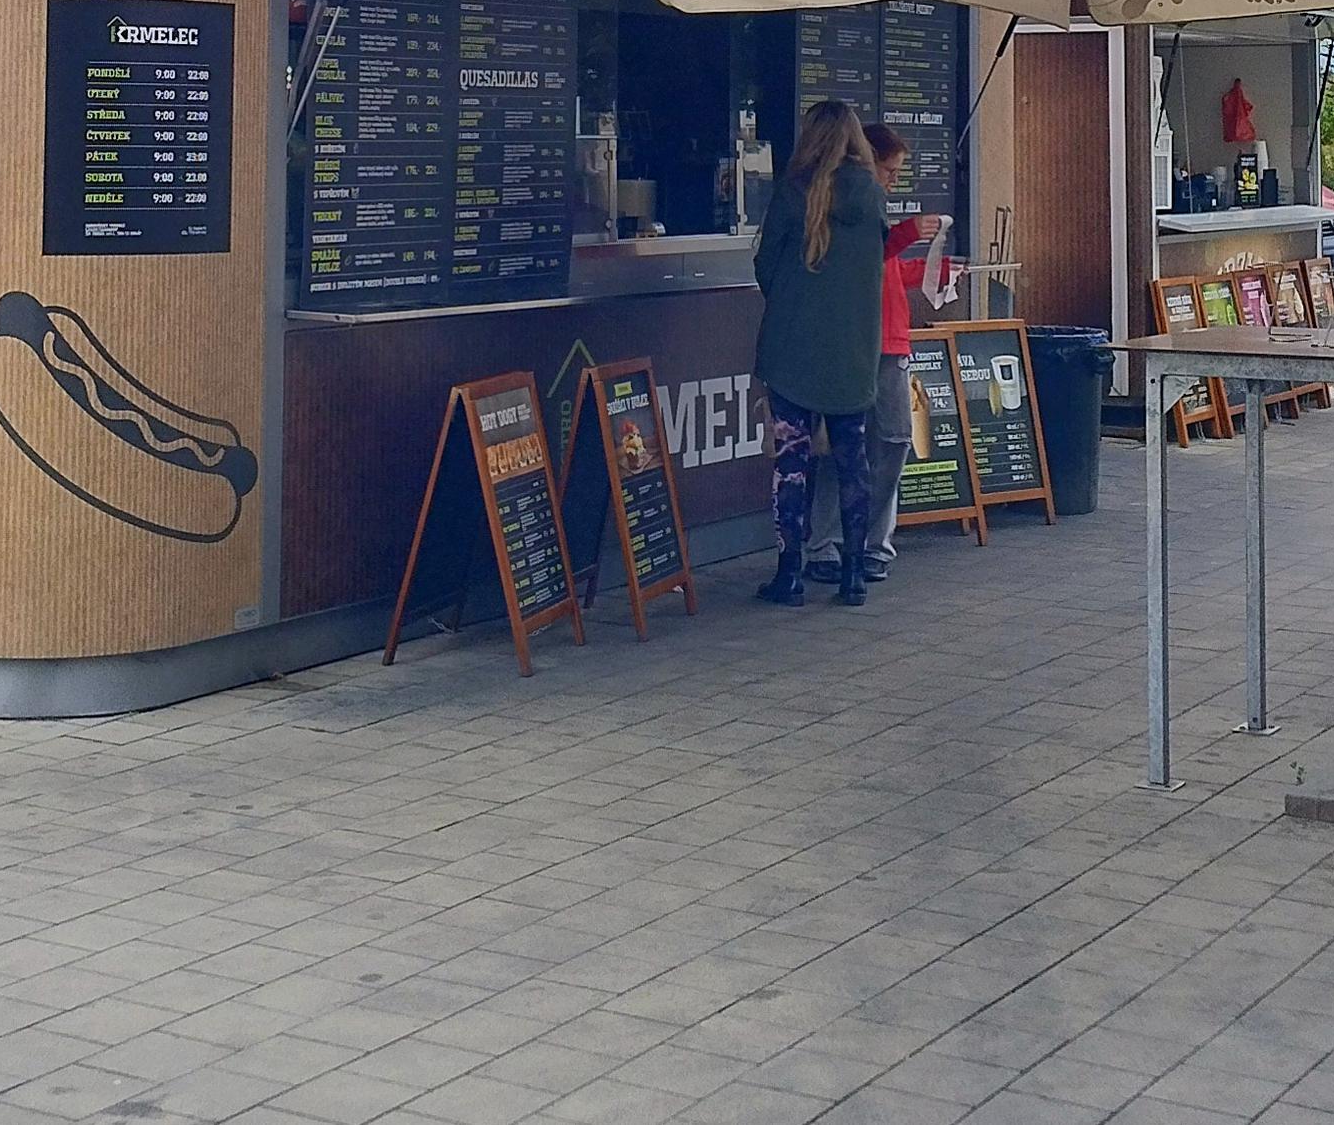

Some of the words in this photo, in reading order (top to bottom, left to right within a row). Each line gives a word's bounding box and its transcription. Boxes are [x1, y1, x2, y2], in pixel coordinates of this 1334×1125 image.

[115, 26, 199, 45] KRMELEC
[86, 67, 131, 80] PONDĚLÍ
[155, 69, 176, 80] 9:00
[187, 70, 210, 81] 22:00
[459, 69, 539, 91] QUESADILLAS
[86, 87, 120, 99] ÚTERÝ
[154, 89, 176, 101] 9:00
[187, 90, 209, 101] 22:00
[86, 107, 126, 120] STŘEDA
[154, 110, 175, 121] 9:00
[186, 110, 208, 122] 22:00
[86, 128, 131, 141] ČTVRTEK
[154, 131, 175, 142] 9:00
[186, 131, 208, 142] 22:00
[85, 149, 118, 162] PÁTEK
[153, 151, 174, 162] 9:00
[85, 172, 124, 183] SOBOTA
[153, 172, 174, 183] 9:00
[85, 190, 124, 203] NEDĚLE
[152, 192, 173, 203] 9:00
[185, 192, 207, 204] 22:00
[960, 368, 991, 382] SEBOU
[925, 385, 952, 398] VELKÉ
[480, 410, 498, 432] HOT
[497, 406, 519, 427] DOGY
